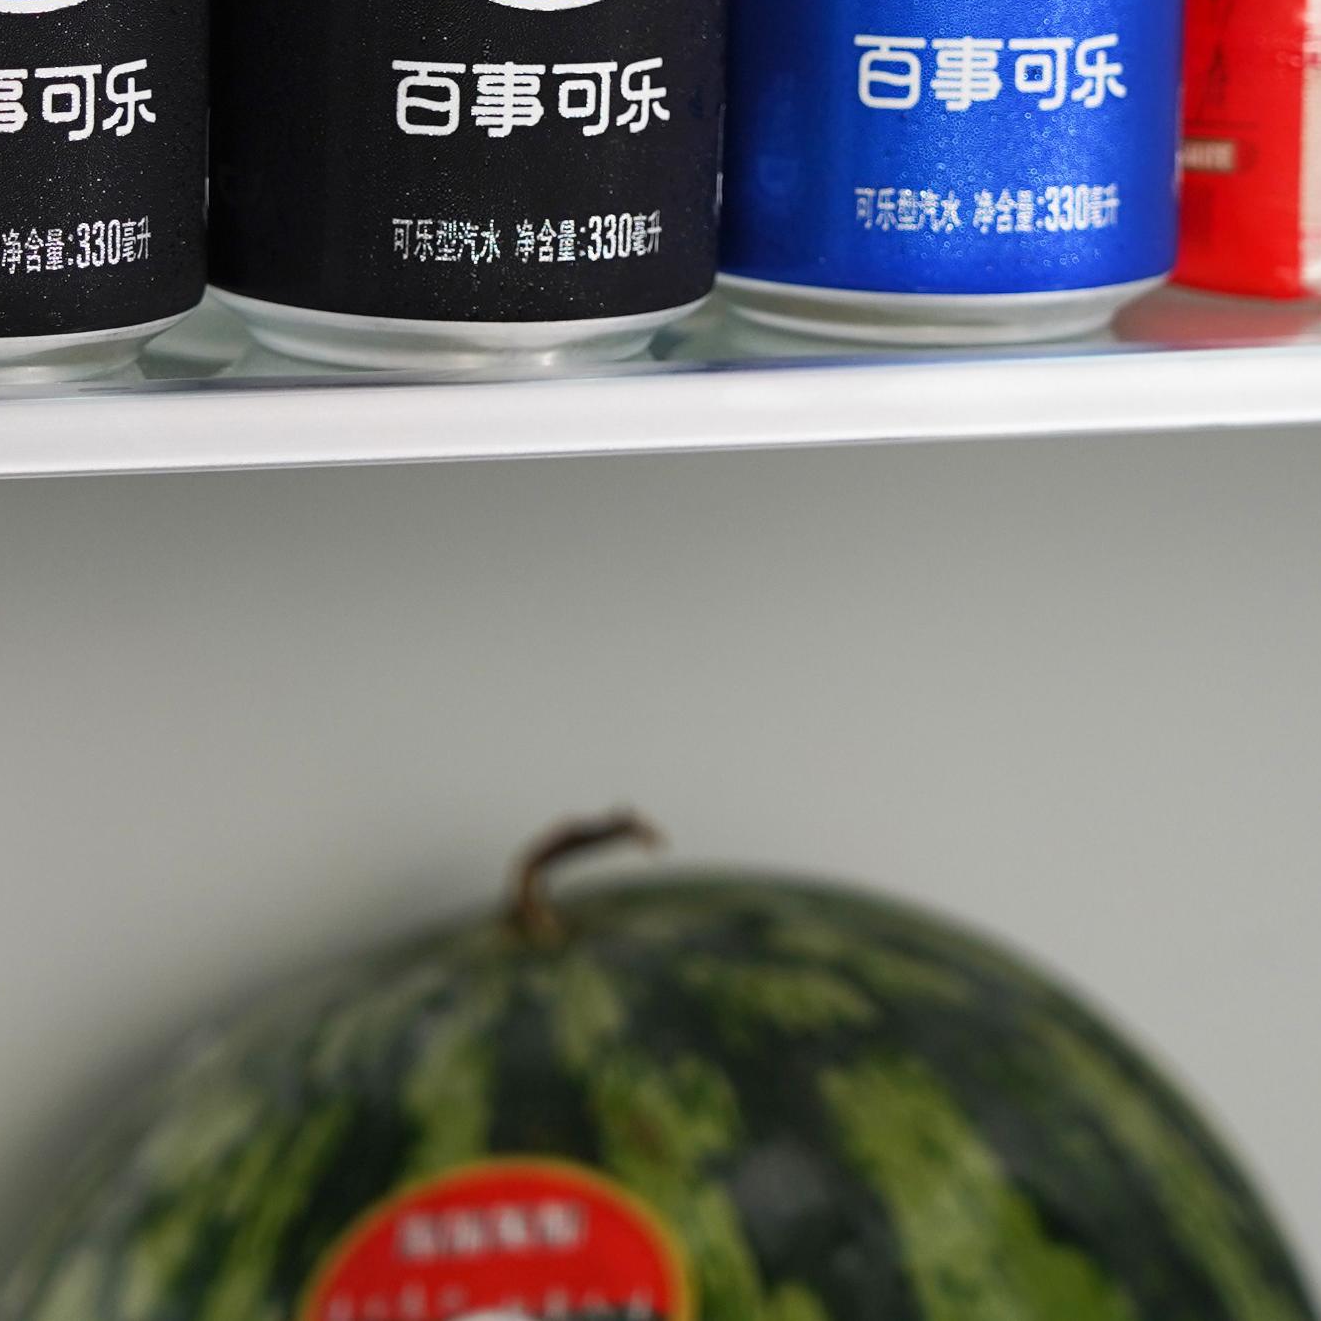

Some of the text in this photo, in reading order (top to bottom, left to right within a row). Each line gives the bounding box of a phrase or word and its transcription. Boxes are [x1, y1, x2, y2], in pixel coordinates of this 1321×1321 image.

[391, 56, 671, 138] 百事可乐
[853, 33, 1127, 111] 百事可乐
[391, 210, 663, 265] 可乐型汽水 净含量:330毫升
[854, 183, 1121, 234] 可乐型汽水 净含量:330毫升
[1, 215, 152, 275] 净含量:330毫升
